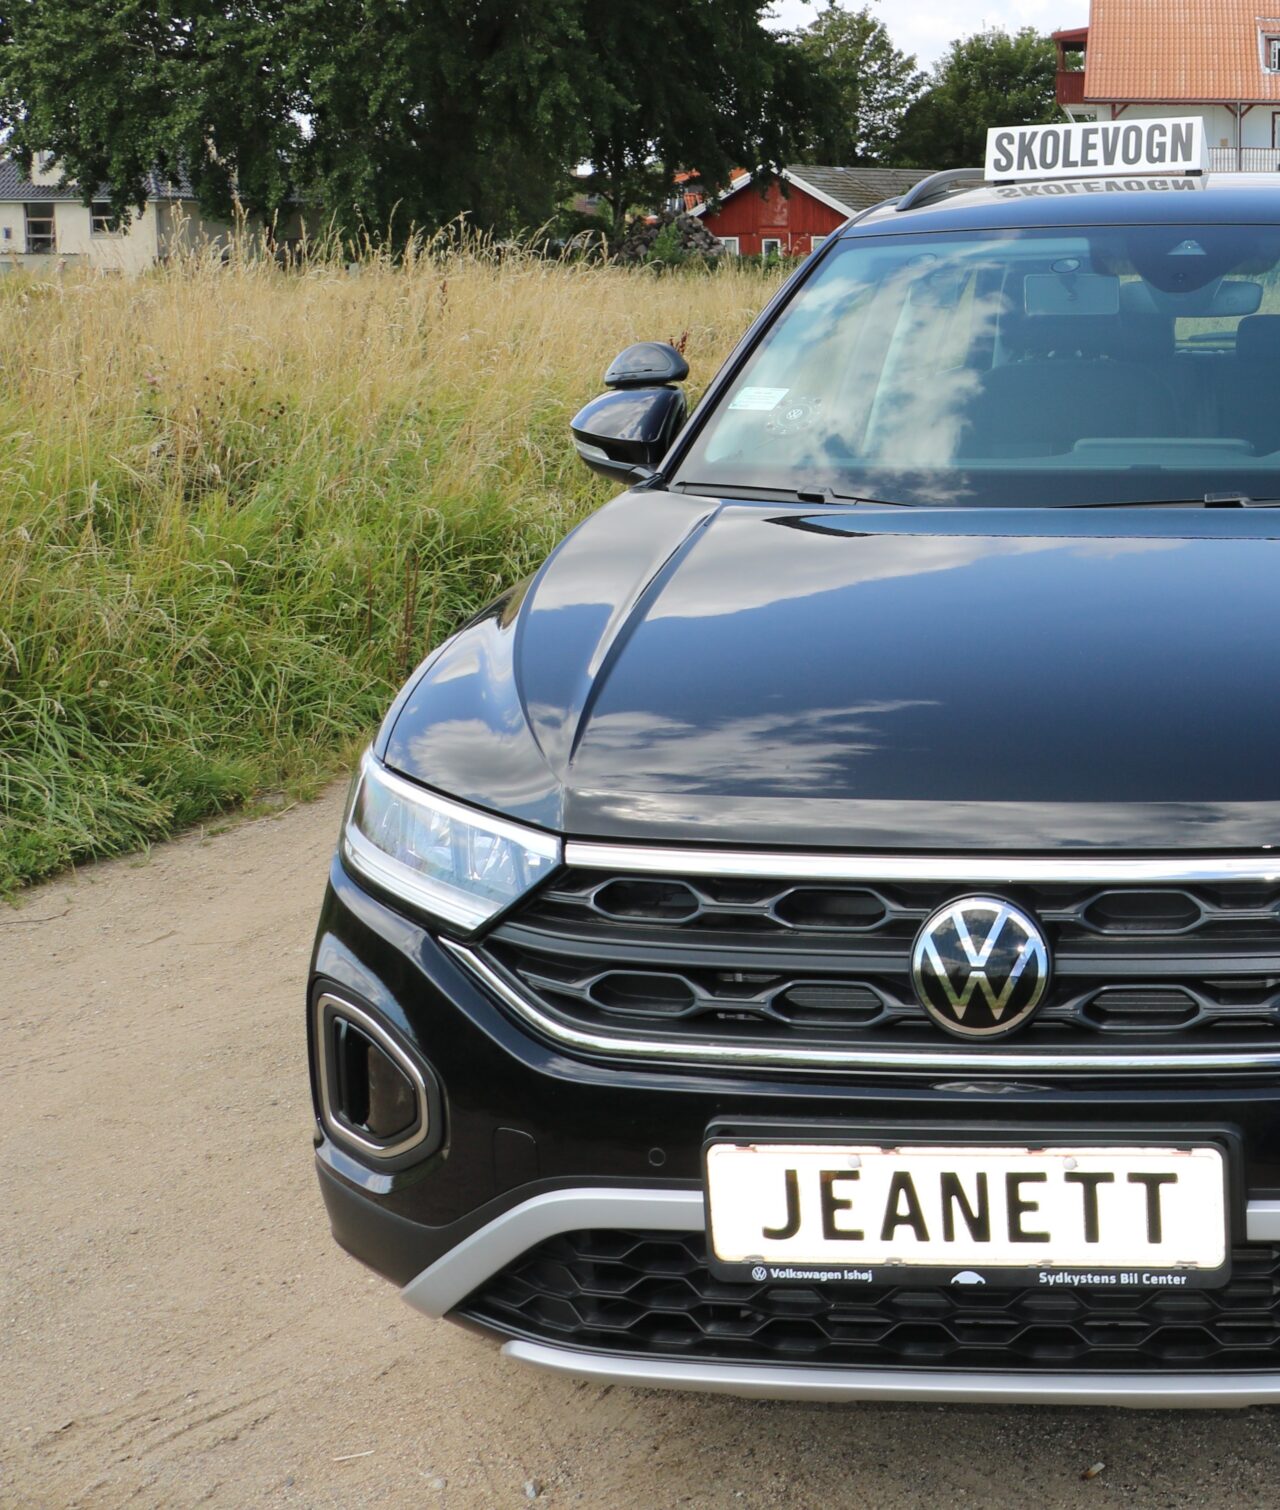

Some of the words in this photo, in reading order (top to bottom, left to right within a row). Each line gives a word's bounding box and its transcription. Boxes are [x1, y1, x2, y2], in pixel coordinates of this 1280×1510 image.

[993, 122, 1194, 172] SKOLEVOGN
[762, 1169, 1178, 1244] JEANETT
[770, 1268, 841, 1281] Volkswagen
[844, 1269, 873, 1282] Ishøj
[1039, 1272, 1116, 1286] Sydkystens
[1120, 1272, 1138, 1284] Bil
[1142, 1273, 1187, 1285] Center
